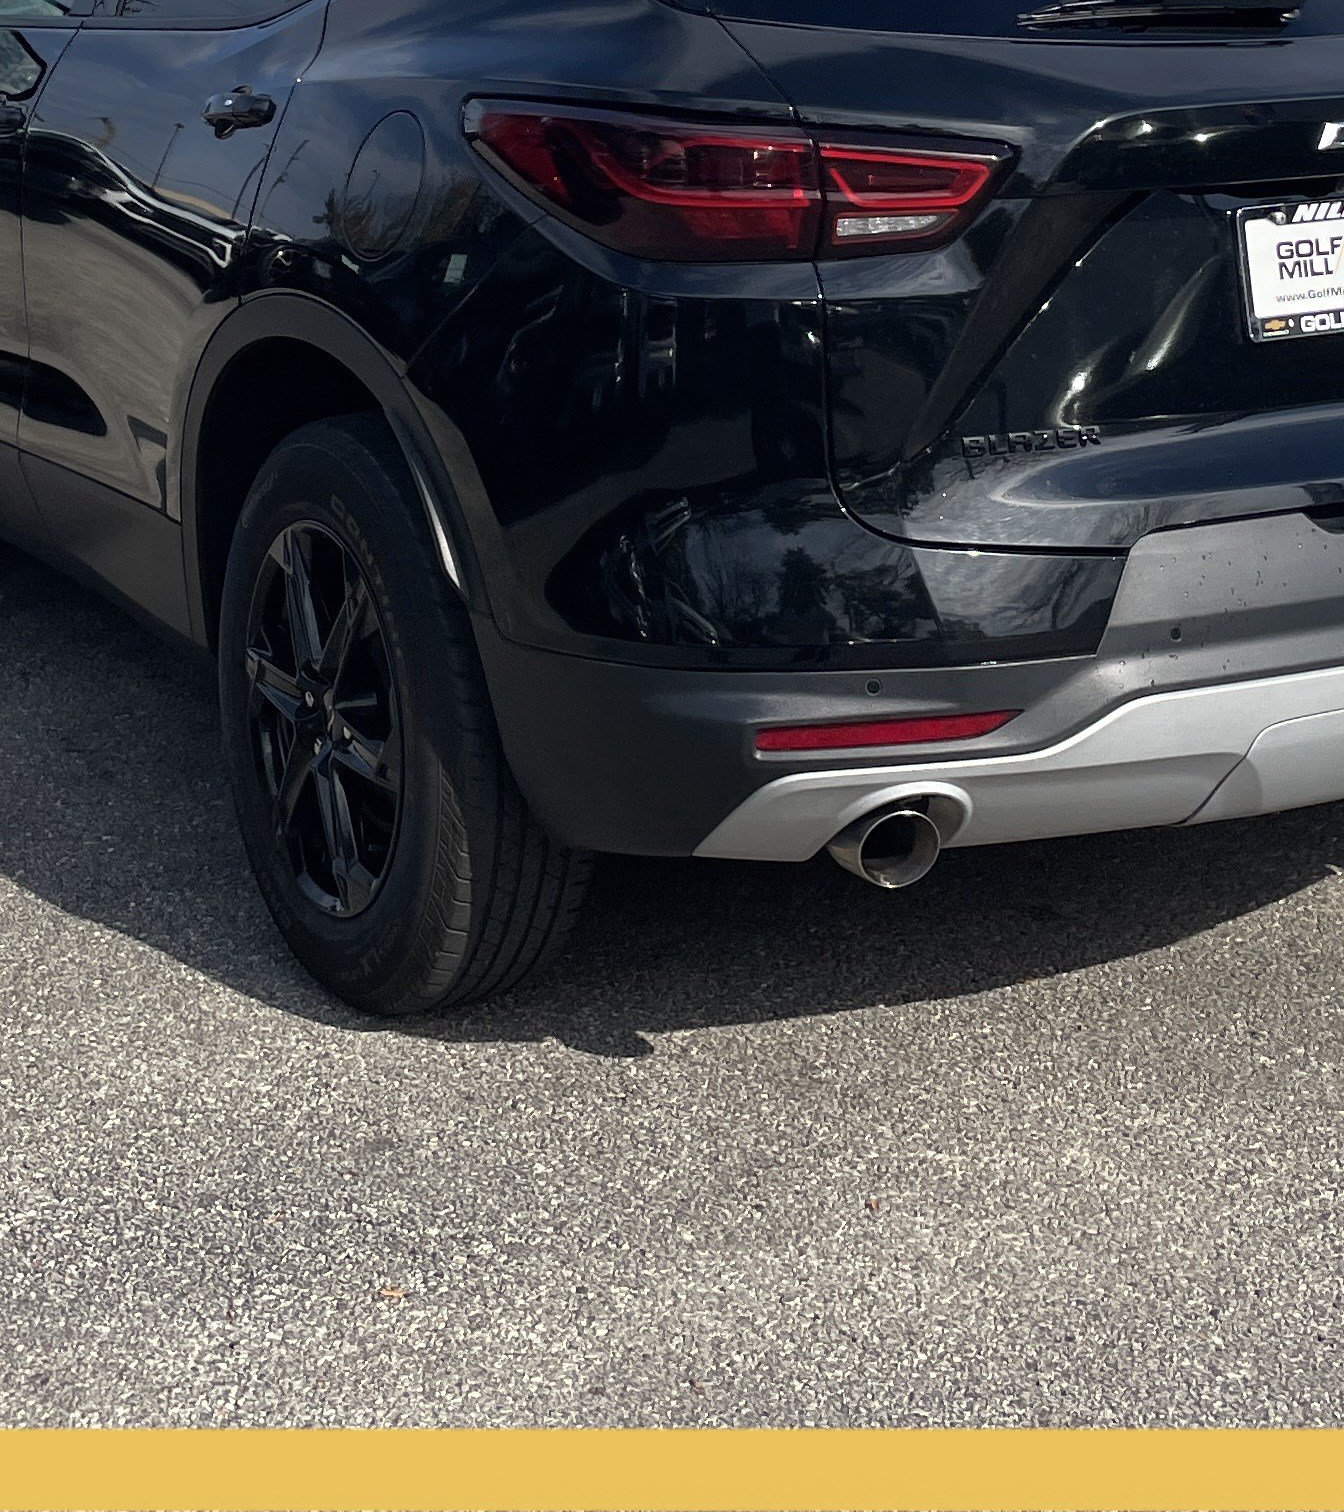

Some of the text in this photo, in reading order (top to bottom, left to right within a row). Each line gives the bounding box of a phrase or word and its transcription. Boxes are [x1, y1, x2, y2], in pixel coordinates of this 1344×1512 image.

[1276, 236, 1343, 260] GOLF
[1278, 256, 1334, 280] MILL
[962, 425, 1101, 459] BLAZER
